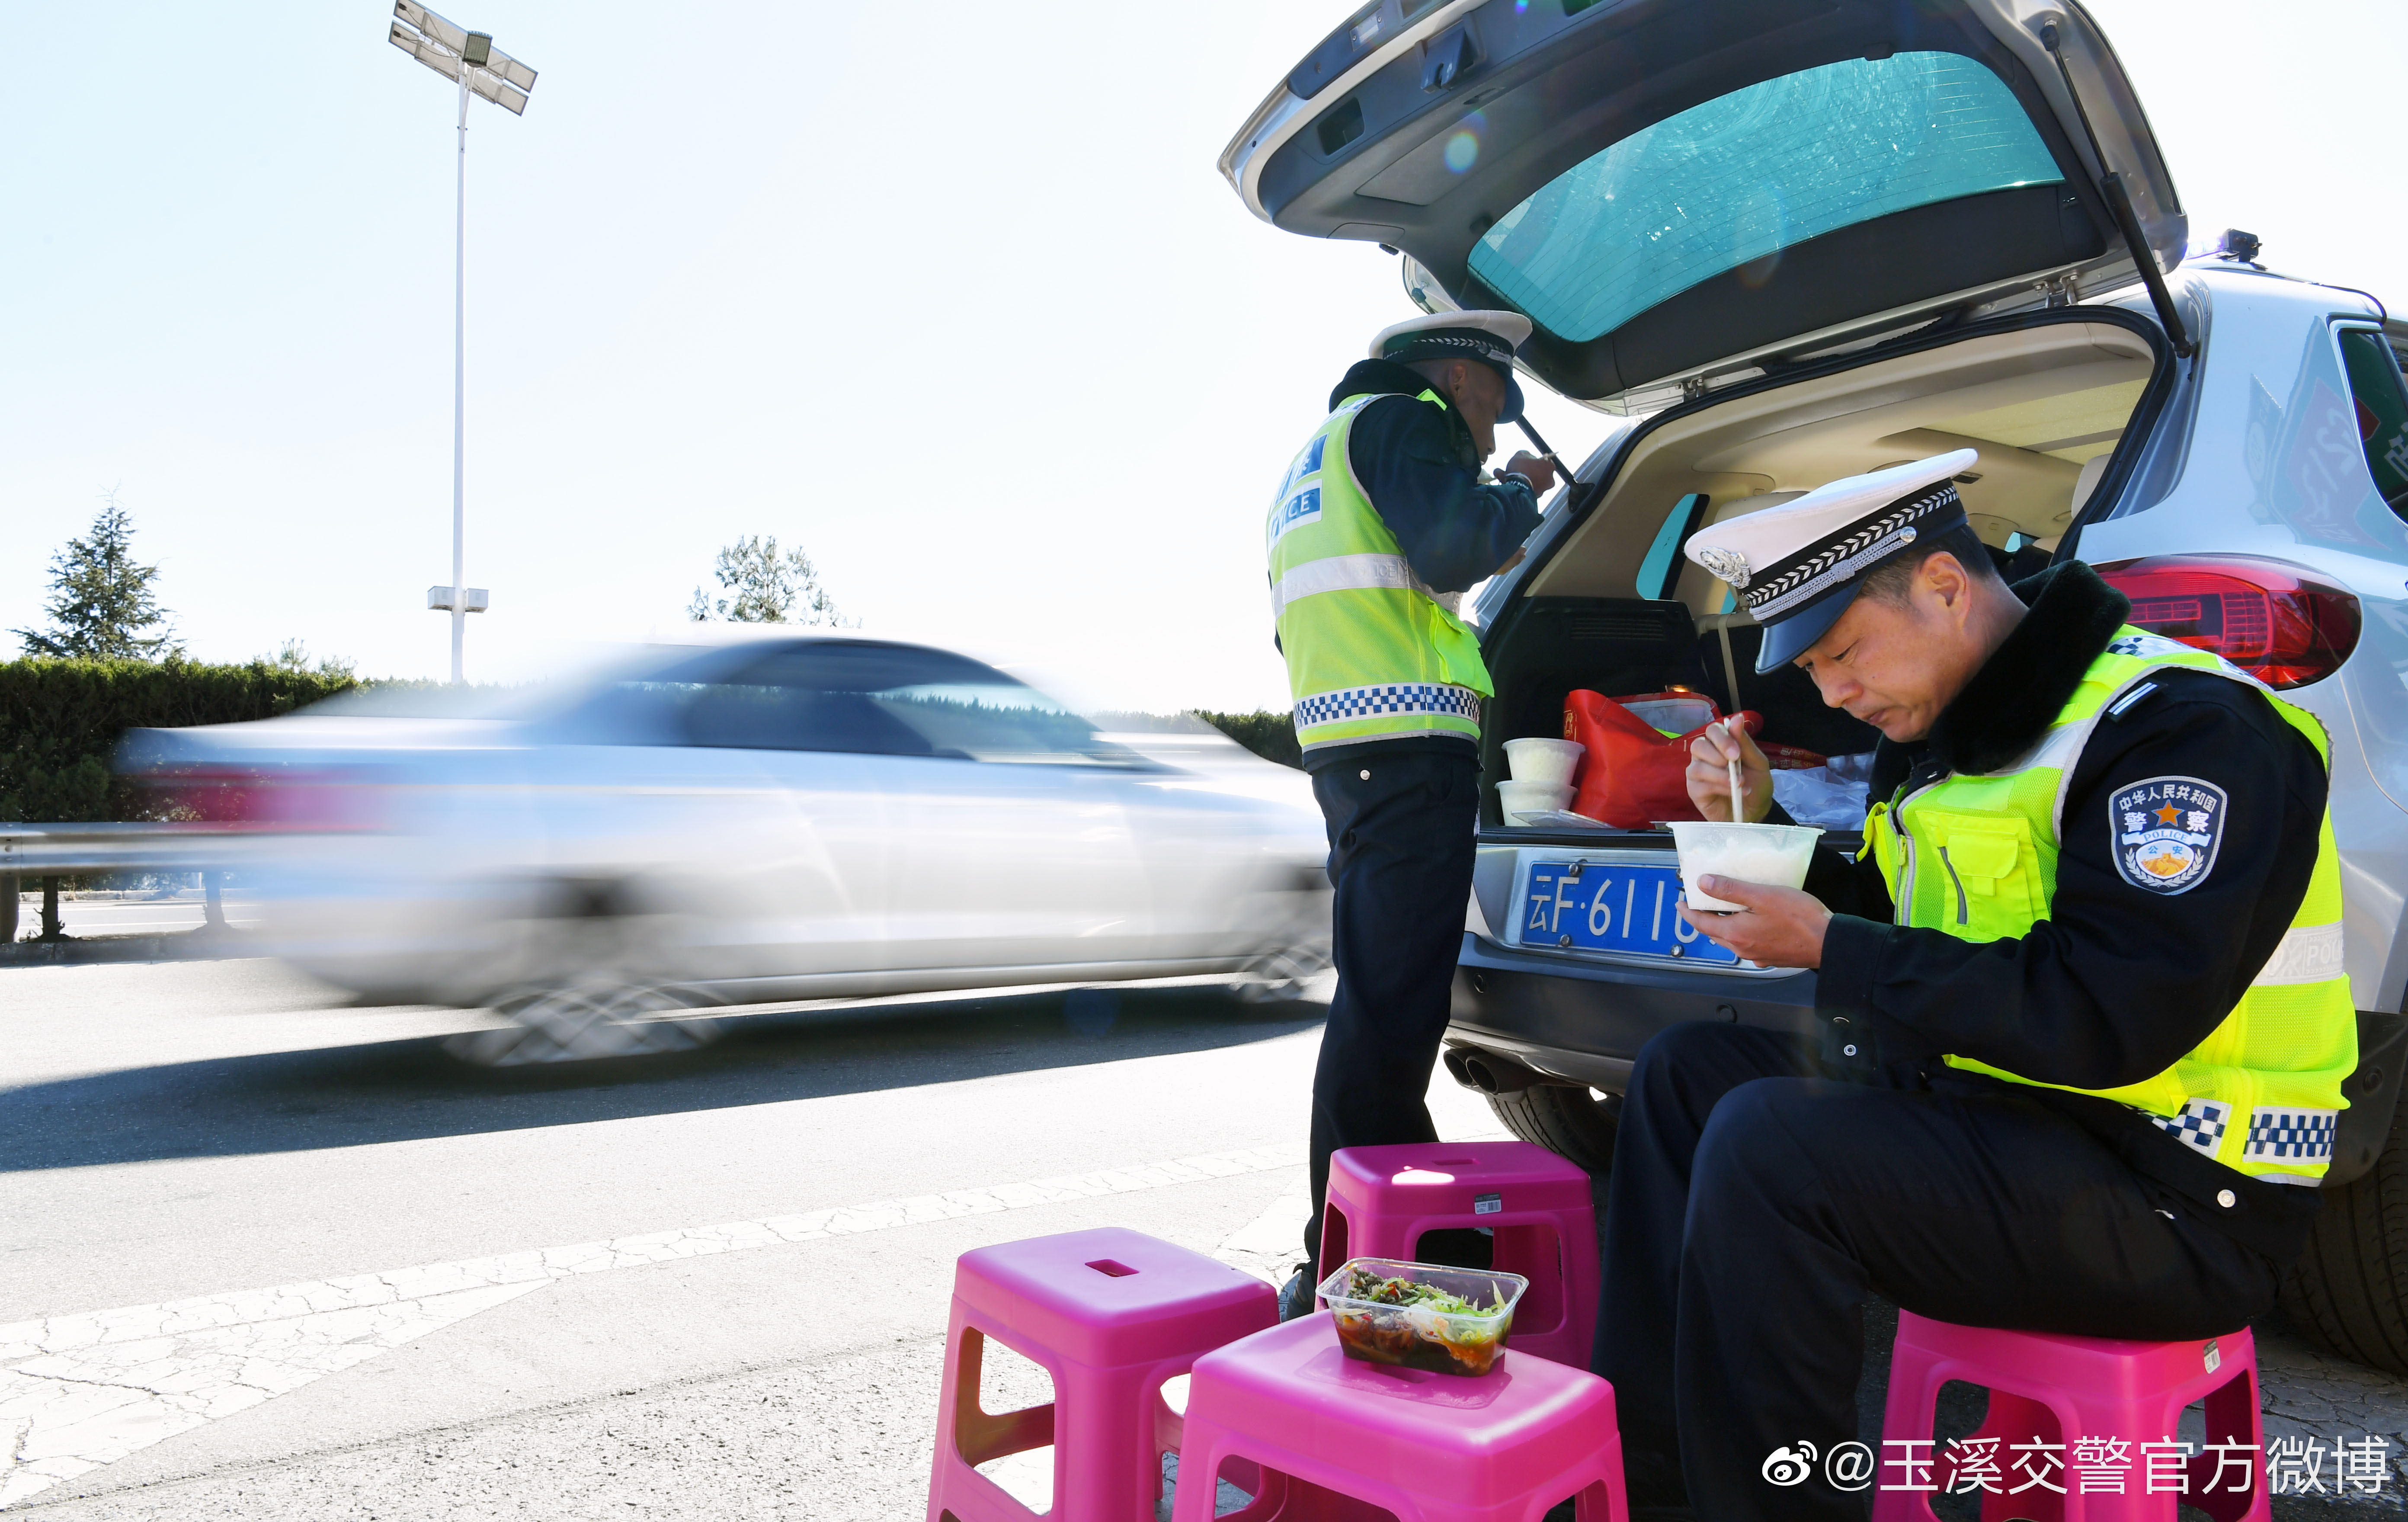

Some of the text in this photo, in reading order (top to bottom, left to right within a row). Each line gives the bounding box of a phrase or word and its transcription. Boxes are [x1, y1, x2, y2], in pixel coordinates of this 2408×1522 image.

[2119, 784, 2217, 813] 中华人民共和国
[2124, 811, 2210, 832] 警察
[2144, 830, 2187, 842] POLICE
[2148, 846, 2183, 854] 公安
